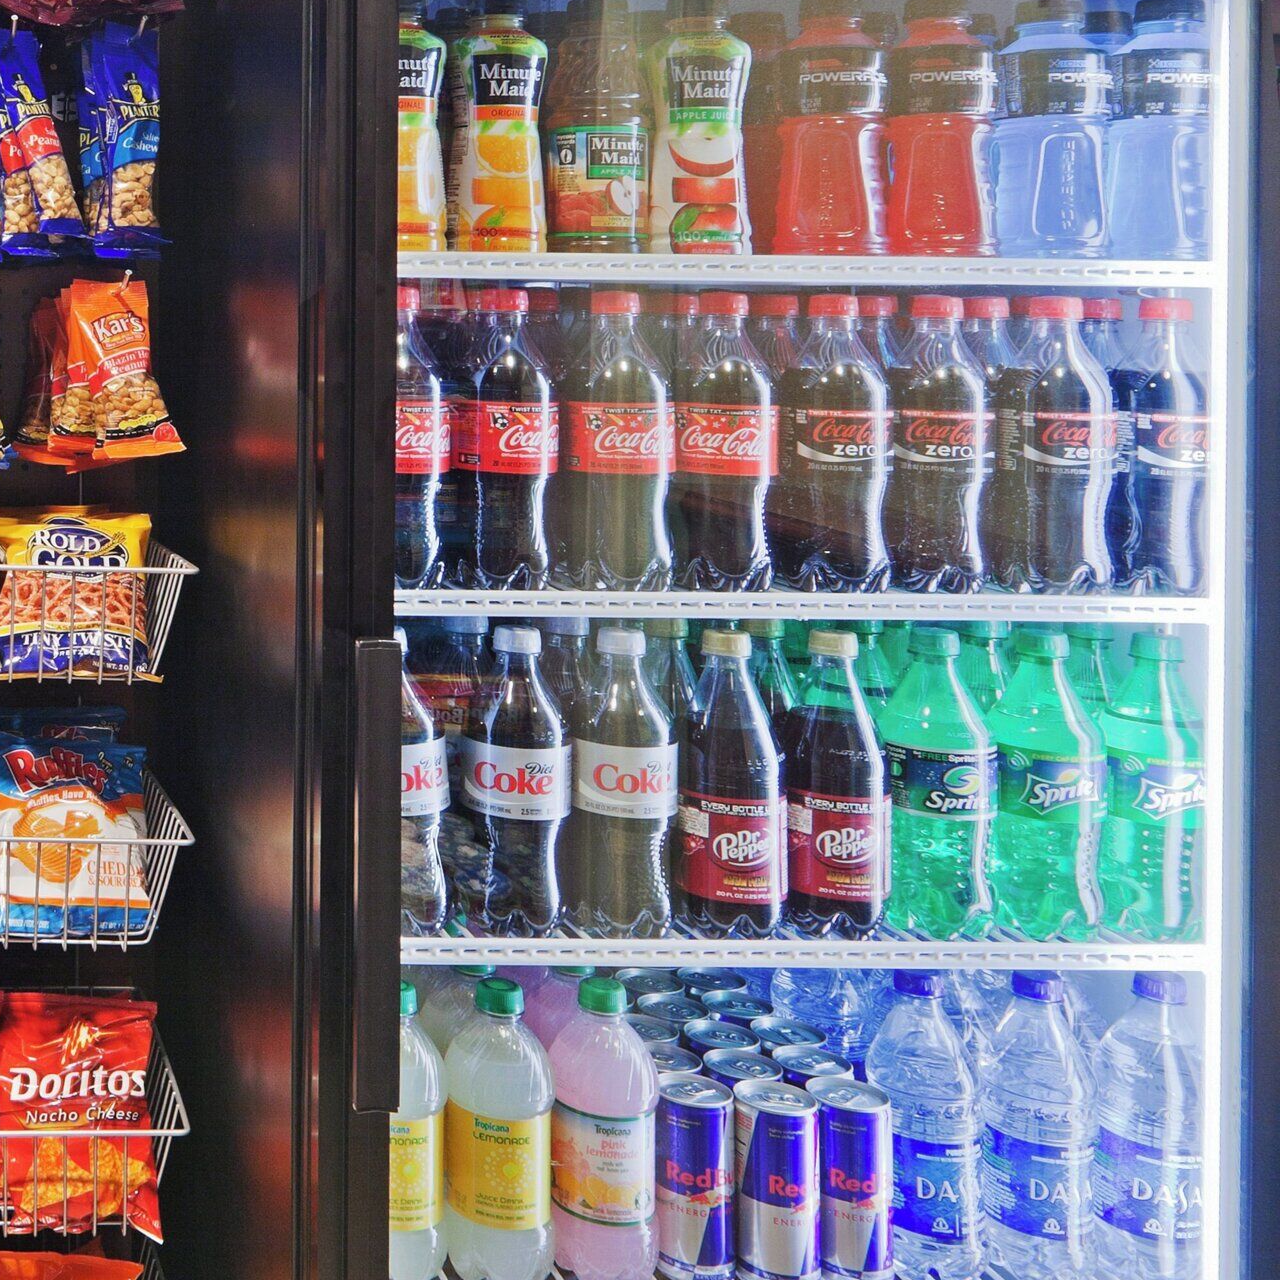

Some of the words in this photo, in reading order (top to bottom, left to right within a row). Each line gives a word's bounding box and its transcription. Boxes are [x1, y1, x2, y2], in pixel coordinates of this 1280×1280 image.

[683, 81, 730, 99] Maid
[676, 112, 706, 120] APPLE
[601, 151, 641, 165] Maid
[94, 312, 144, 342] Kar's
[833, 444, 877, 457] zero
[925, 445, 974, 458] zero
[35, 529, 100, 552] ROLD
[3, 747, 109, 796] Ruffles
[474, 761, 554, 796] Coke
[1032, 777, 1094, 806] Sprite
[701, 800, 729, 811] EVERY
[731, 802, 765, 813] BOTTLE
[737, 829, 761, 845] Dr
[10, 1060, 147, 1102] Doritos
[25, 1109, 78, 1125] Nacho
[86, 1103, 140, 1123] Cheese
[473, 1117, 510, 1134] Tropicana
[473, 1130, 531, 1145] LEMONADE
[600, 1138, 626, 1152] pink
[665, 1162, 711, 1188] Red
[830, 1167, 877, 1193] Red
